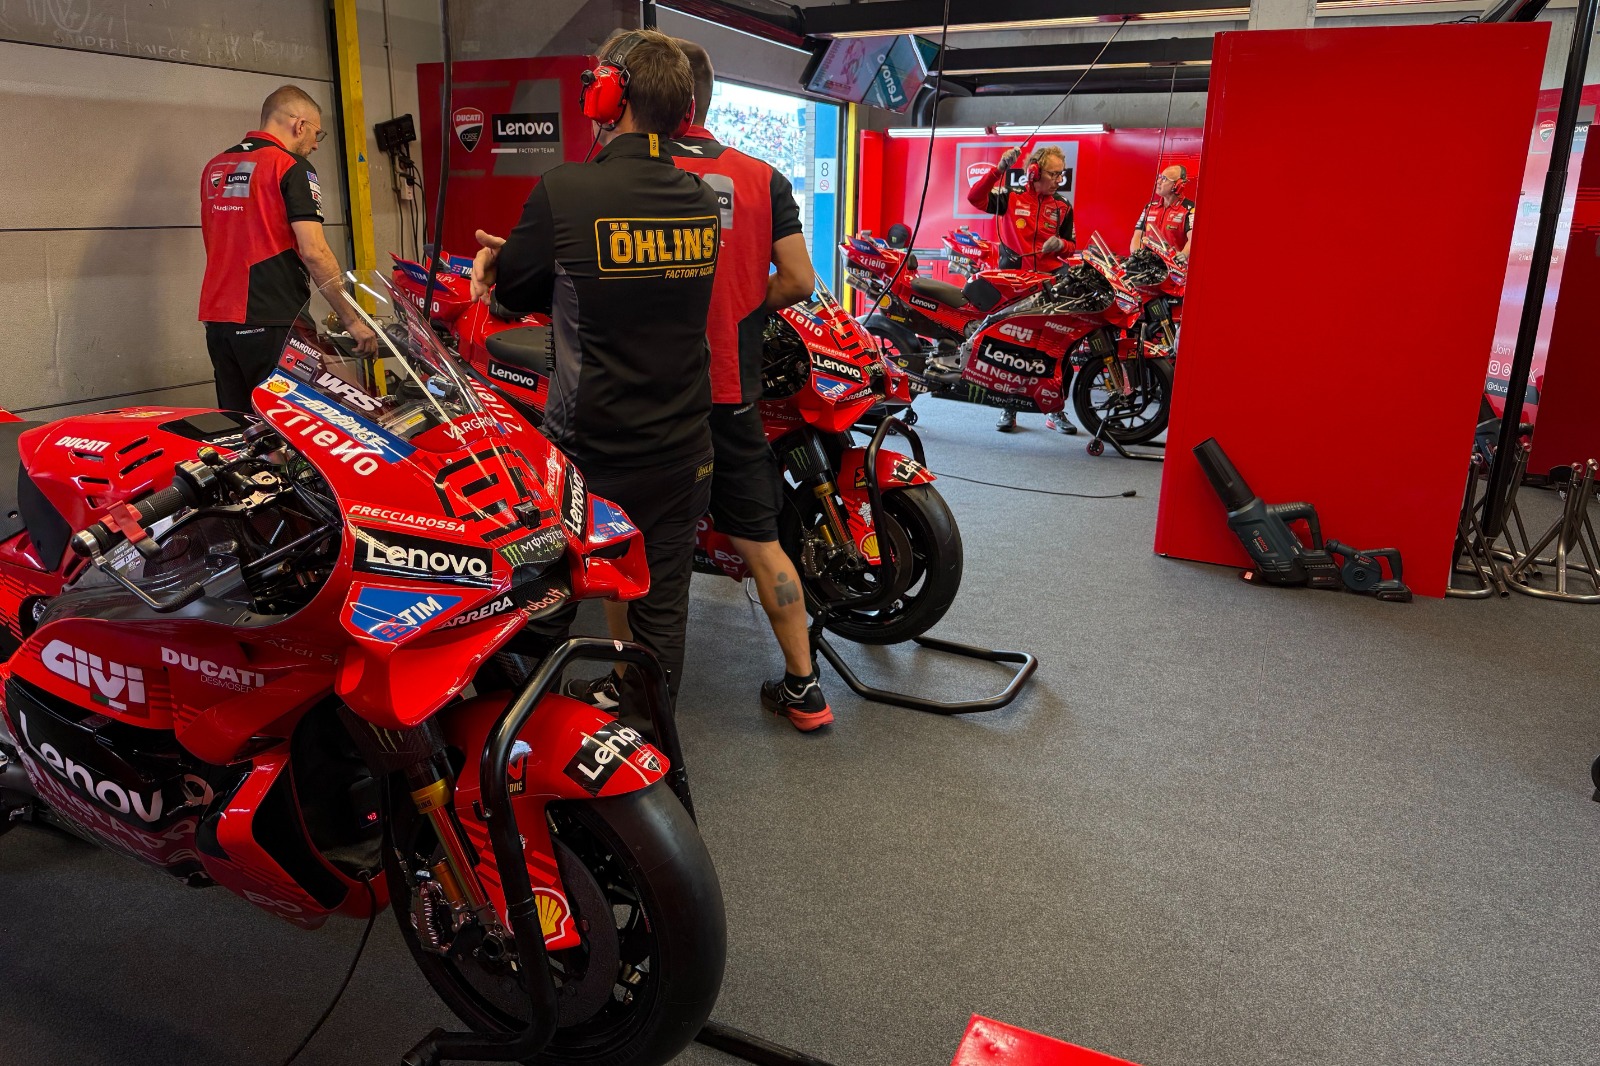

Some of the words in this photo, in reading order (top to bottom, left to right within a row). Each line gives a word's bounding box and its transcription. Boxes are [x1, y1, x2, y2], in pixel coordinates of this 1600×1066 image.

[497, 119, 554, 136] Lenovo
[821, 161, 829, 177] 8
[970, 167, 991, 175] DUCA
[609, 222, 716, 264] ÖHLINS
[665, 268, 699, 279] FACTORY
[699, 265, 715, 276] RACING
[911, 296, 937, 310] Lenovo
[999, 323, 1034, 341] GIVI
[1045, 321, 1075, 332] DUCATI
[289, 338, 322, 360] MARQUEZ
[984, 344, 1046, 374] Lenovo
[1493, 344, 1511, 356] Join
[296, 360, 313, 373] Lenovo
[490, 363, 535, 387] Lenovo
[816, 355, 861, 378] Lenovo
[990, 366, 1039, 386] NetApp
[316, 372, 383, 412] WRS
[993, 382, 1027, 394] elica
[987, 394, 1033, 407] MONSTER
[55, 436, 111, 452] DUCATI
[565, 472, 584, 535] Lenovo
[349, 504, 466, 533] FRECCIAROSSA
[607, 521, 634, 534] TIM
[520, 527, 567, 553] MONSTER
[365, 540, 487, 577] Lenovo
[398, 596, 443, 625] TIM
[41, 639, 146, 704] GIVI
[161, 647, 265, 688] DUCATI
[19, 709, 214, 823] Lenovo
